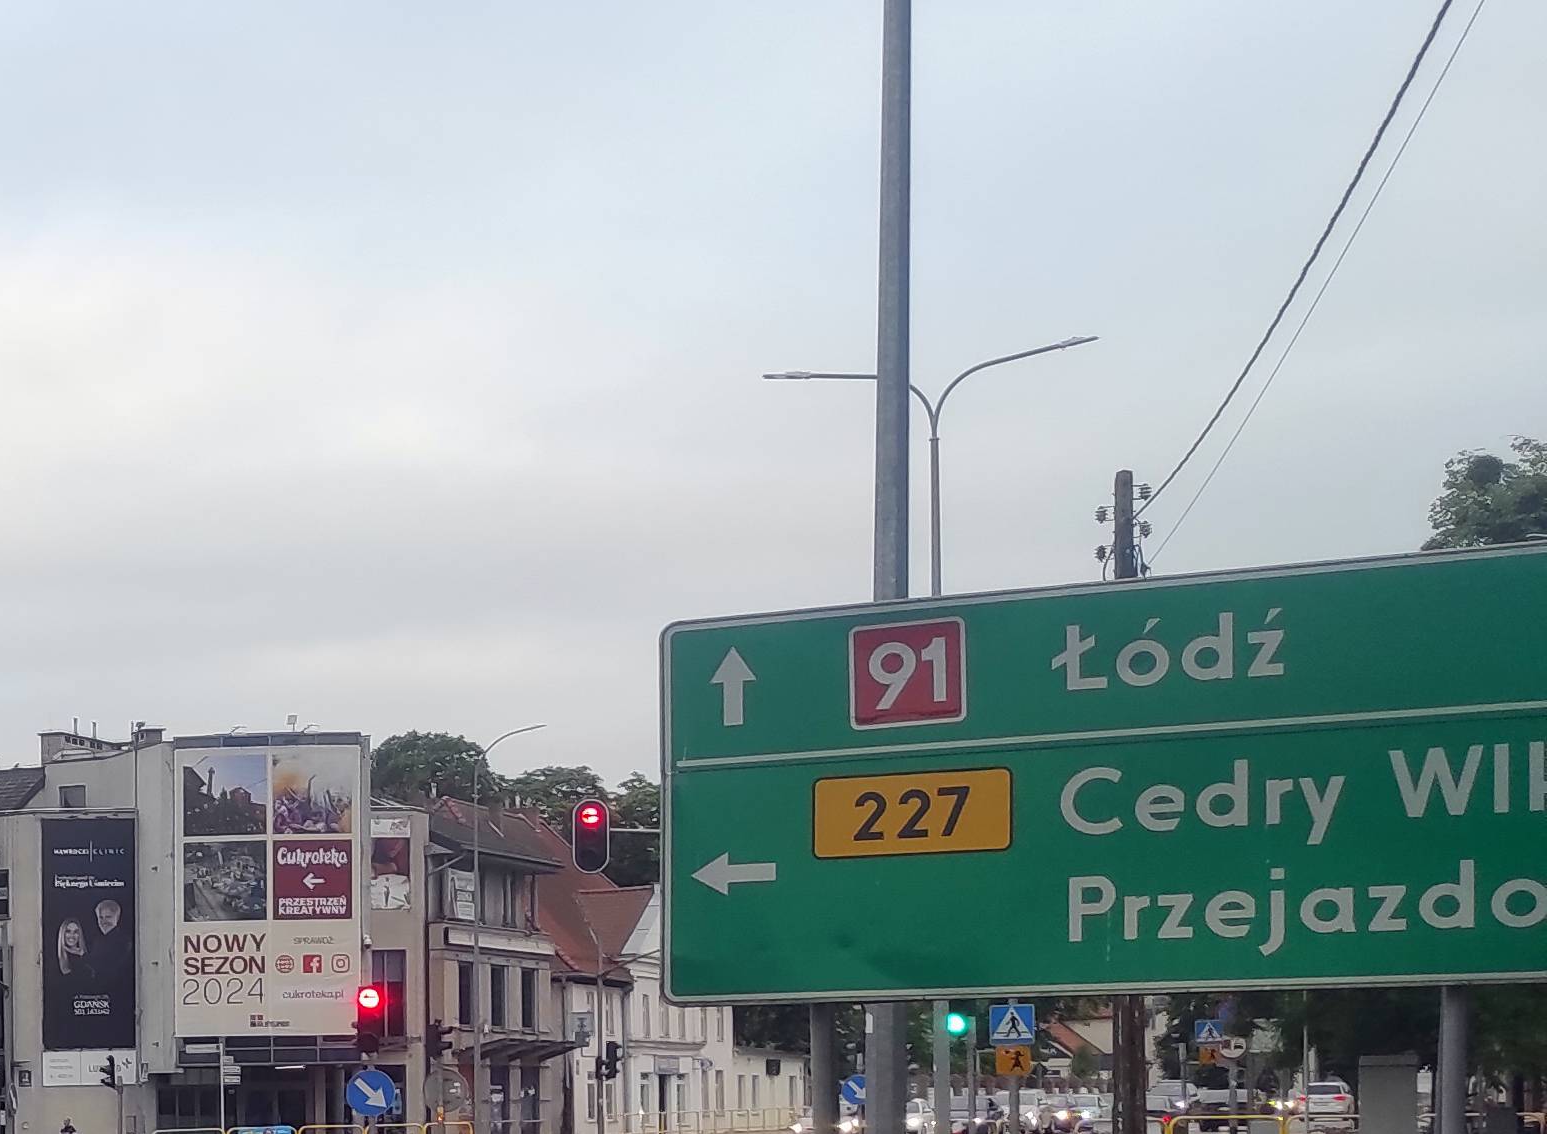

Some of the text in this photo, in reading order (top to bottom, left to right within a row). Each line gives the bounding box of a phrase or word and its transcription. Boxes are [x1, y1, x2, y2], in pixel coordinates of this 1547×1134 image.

[1051, 607, 1285, 690] Łódź
[868, 636, 947, 711] 91
[853, 786, 970, 841] 227
[1060, 759, 1346, 845] Cedry
[277, 846, 348, 868] Cukroteka
[1068, 859, 1547, 956] Przejazdo
[183, 933, 266, 954] NOWY
[183, 955, 266, 976] SEZON
[183, 978, 264, 1006] 2024
[282, 989, 344, 1000] cukroteka.pl
